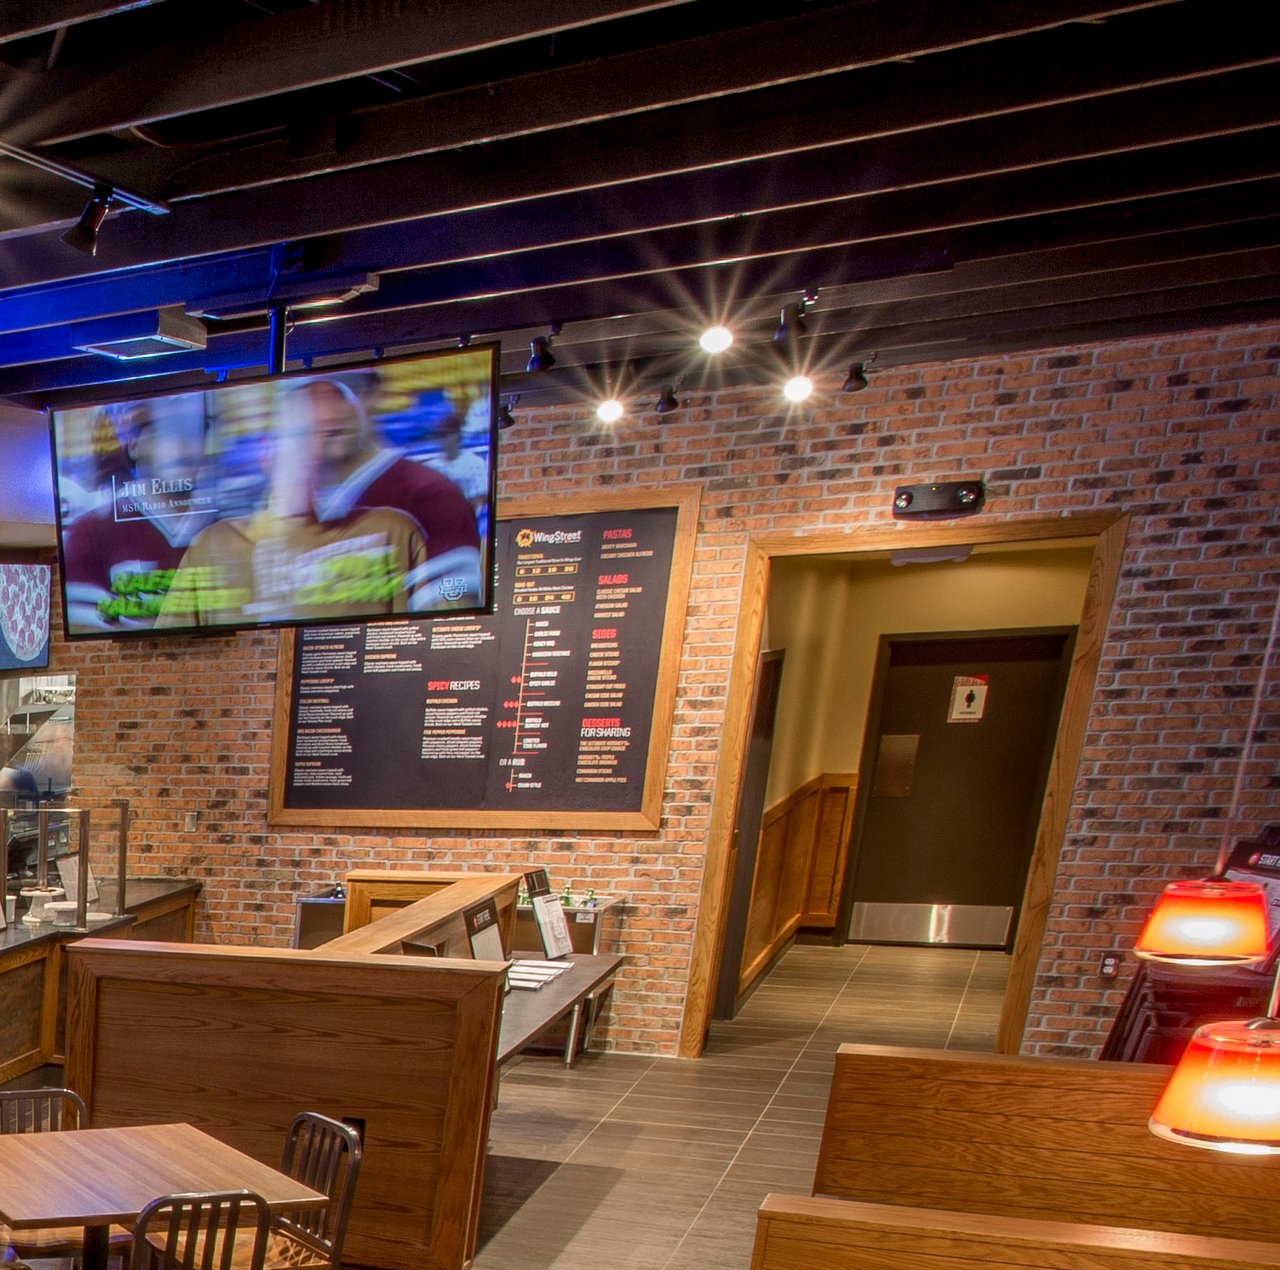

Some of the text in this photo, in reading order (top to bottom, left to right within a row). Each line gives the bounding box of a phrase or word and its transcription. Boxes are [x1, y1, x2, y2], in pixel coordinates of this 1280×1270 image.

[122, 478, 193, 497] JIM ELLIS
[533, 530, 582, 544] WingStreet
[603, 528, 633, 540] PASTAS
[598, 573, 628, 585] SALADS
[540, 605, 561, 615] SAUCE
[592, 628, 618, 640] SIDES
[427, 680, 481, 692] SPICY RECIPES
[582, 717, 622, 728] DESSERTS
[580, 726, 632, 738] FOR SHARING
